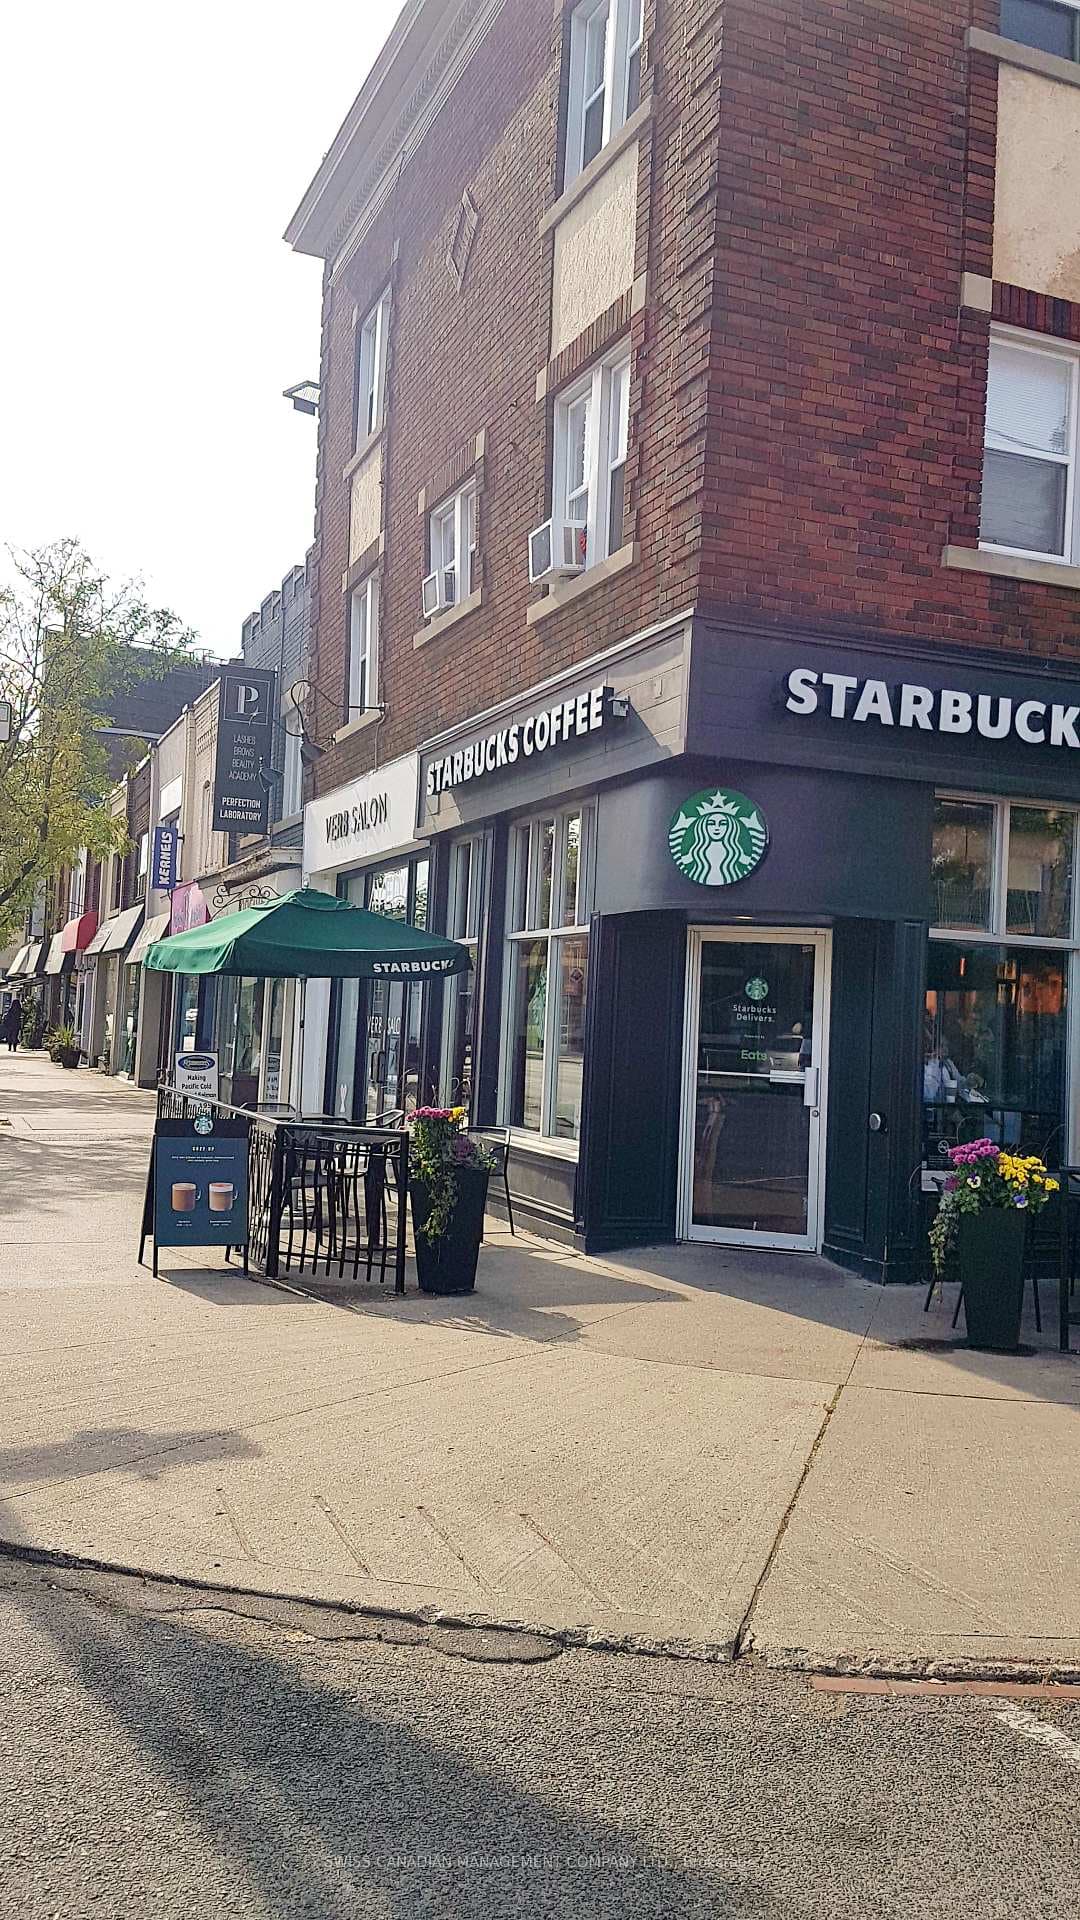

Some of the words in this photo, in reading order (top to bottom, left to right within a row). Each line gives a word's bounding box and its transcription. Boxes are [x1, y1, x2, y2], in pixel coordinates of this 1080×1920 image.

[785, 668, 1080, 749] STARBUCK
[233, 734, 256, 746] LASHES
[426, 724, 519, 795] STARBUCKS
[522, 685, 604, 756] COFFEE
[233, 746, 255, 758] BROWS
[231, 758, 255, 770] BEAUTY
[228, 770, 257, 782] ACADEMY
[222, 797, 261, 809] PERFECTION
[219, 809, 262, 822] LABORATORY
[325, 810, 349, 843] VERB
[351, 792, 388, 834] SALON
[159, 831, 173, 885] KERNELS
[373, 958, 456, 973] STARBUCKS
[733, 1004, 777, 1014] Starbucks
[736, 1013, 776, 1023] Delivers.
[387, 1015, 402, 1036] SALO
[741, 1050, 768, 1061] Eats
